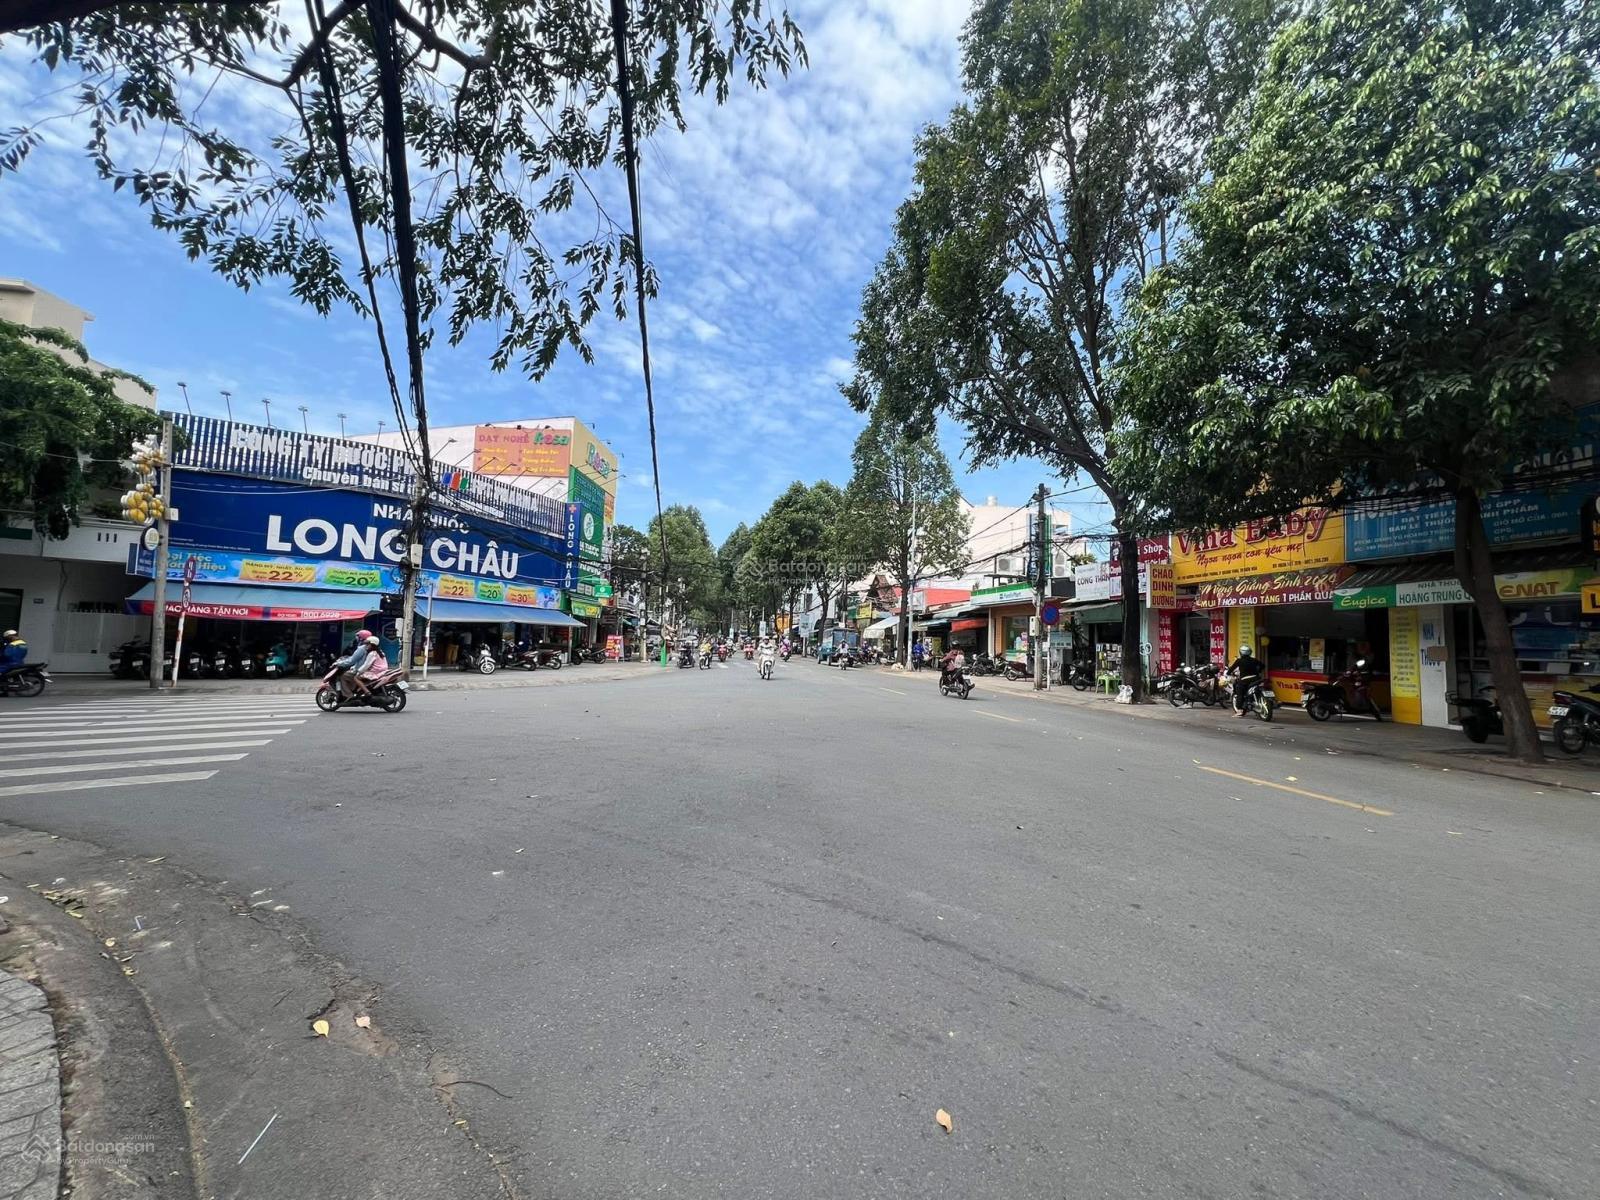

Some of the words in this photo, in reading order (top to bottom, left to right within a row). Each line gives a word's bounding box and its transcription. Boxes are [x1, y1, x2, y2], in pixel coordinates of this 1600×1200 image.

[299, 434, 327, 462] TY
[303, 466, 359, 485] Chuyên
[1143, 545, 1163, 555] Shop
[430, 537, 519, 579] CHÂU
[269, 570, 304, 581] 22%
[345, 575, 378, 587] 20%
[1152, 581, 1174, 592] DINH
[1499, 581, 1559, 597] ENAT
[1341, 595, 1387, 608] Eugica
[1399, 590, 1430, 604] HOÀNG
[1432, 589, 1463, 602] TRUNG
[232, 608, 249, 616] NƠI
[1211, 623, 1224, 634] Loa
